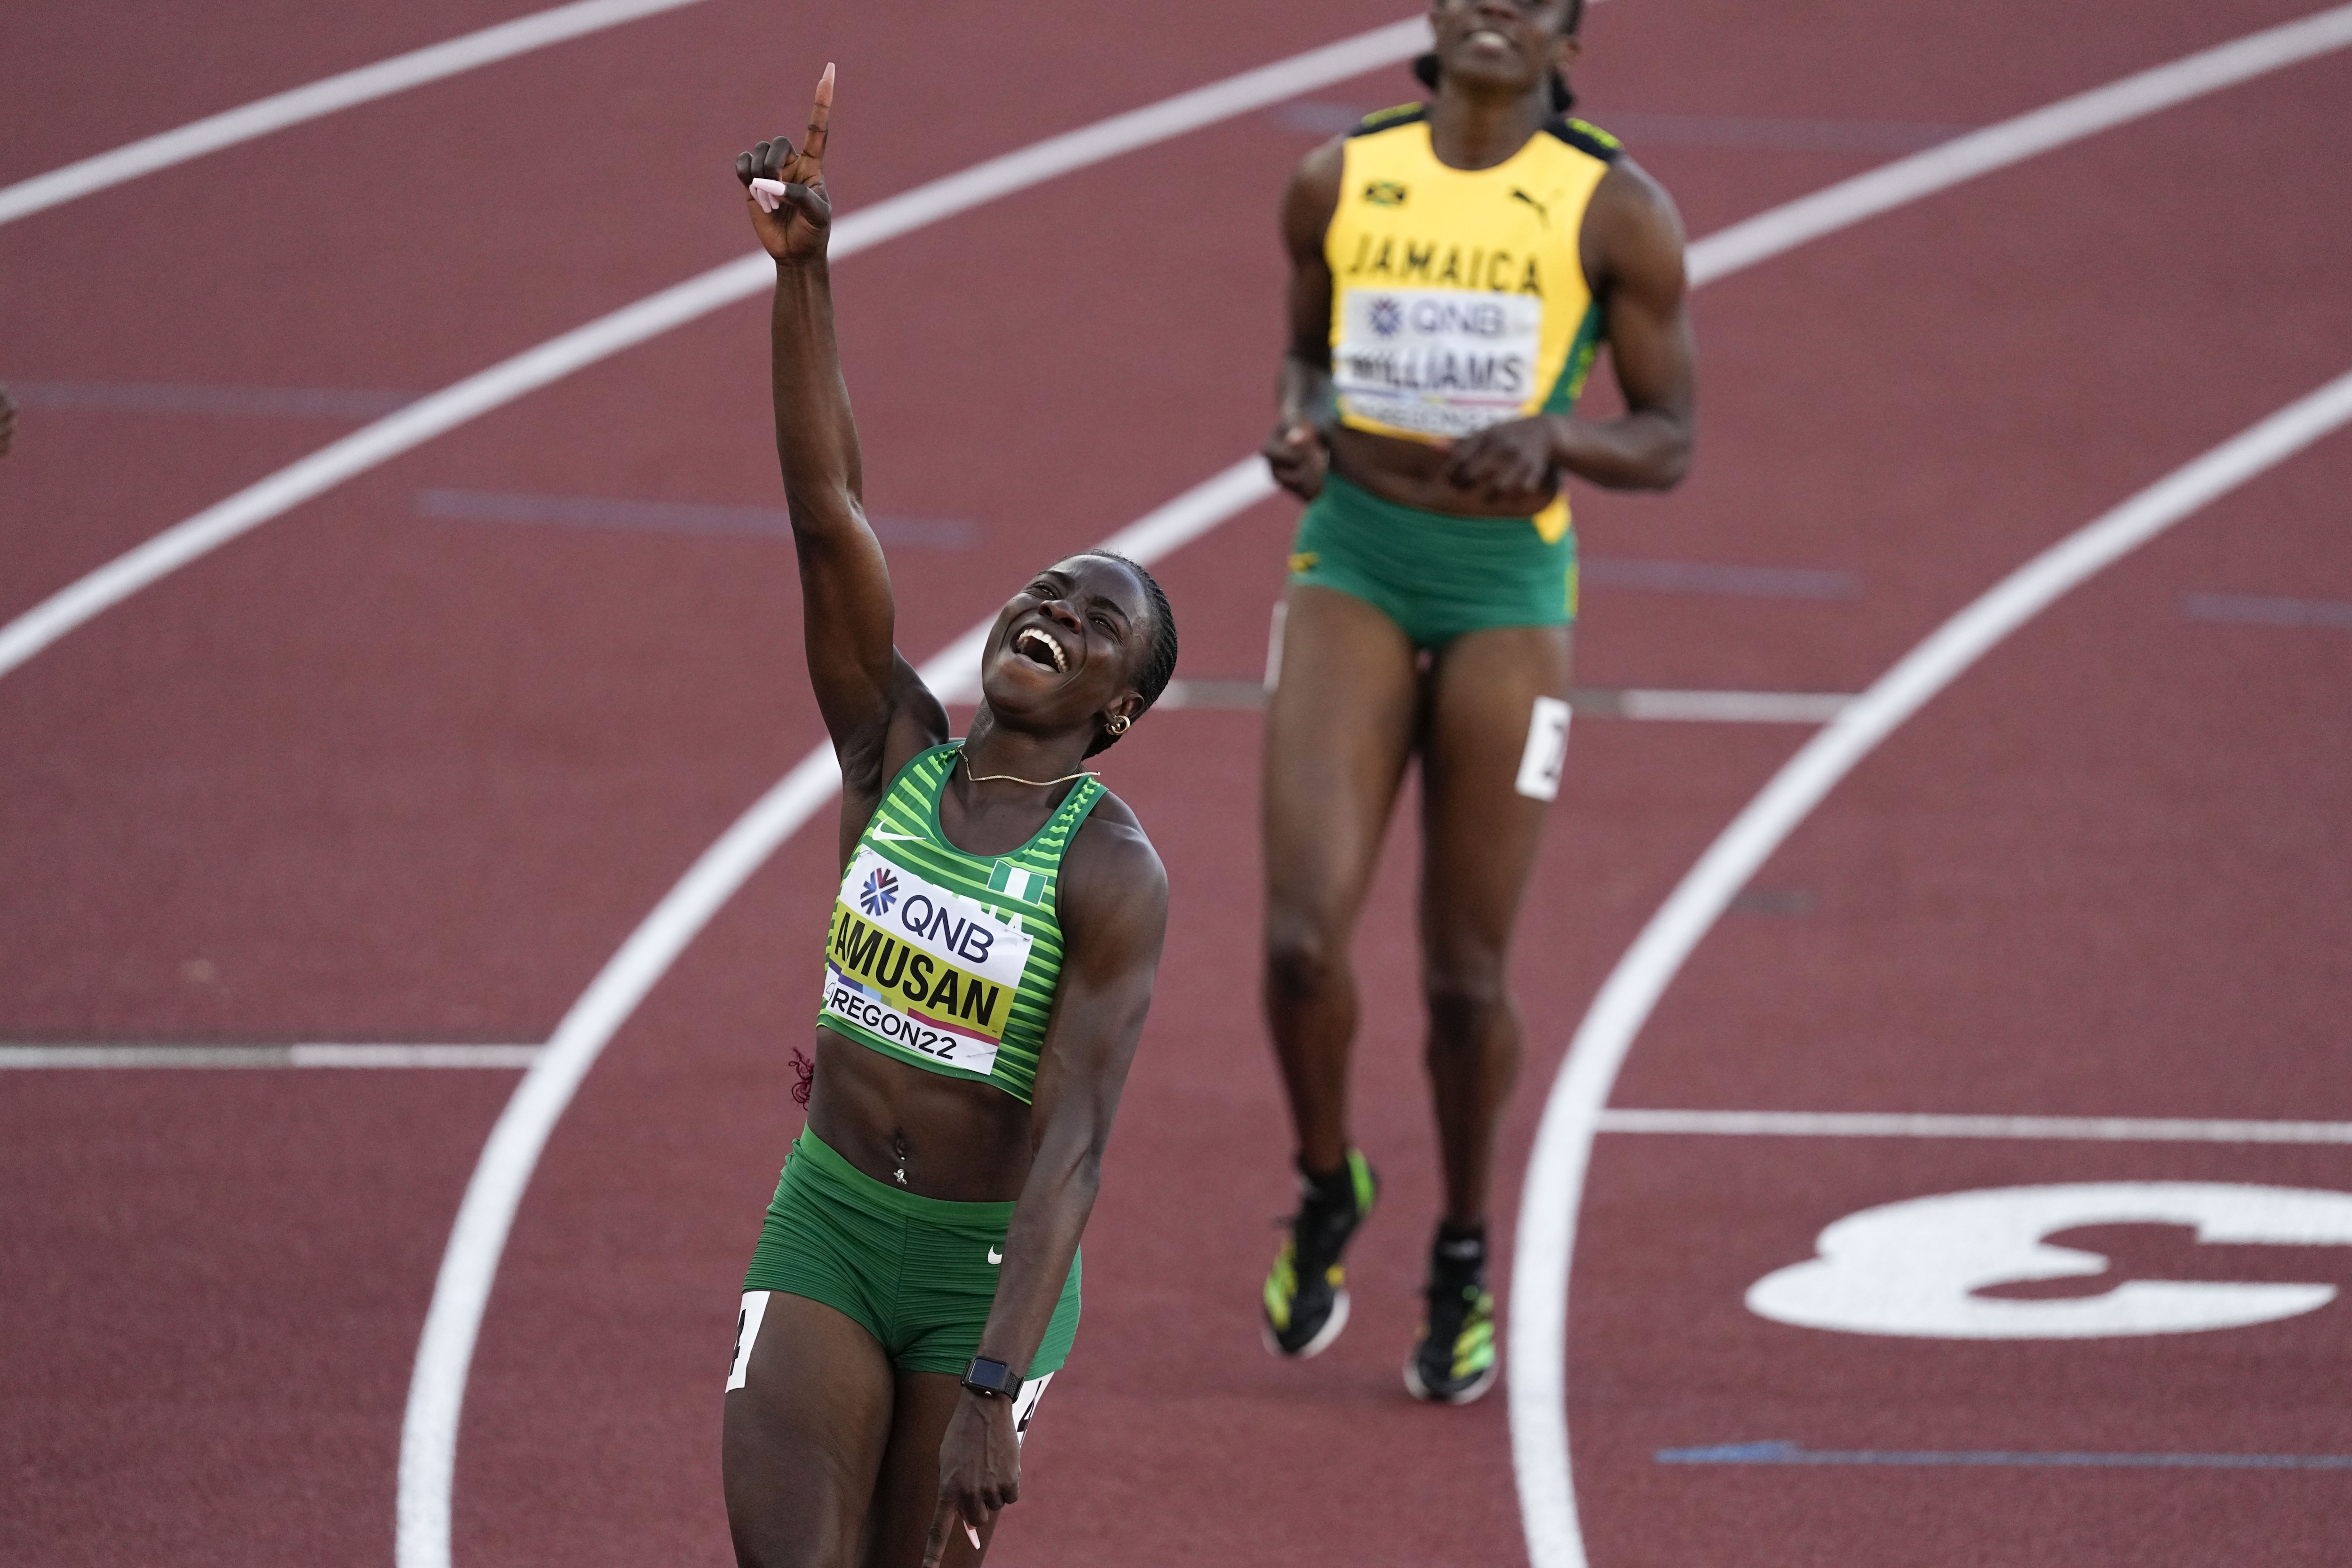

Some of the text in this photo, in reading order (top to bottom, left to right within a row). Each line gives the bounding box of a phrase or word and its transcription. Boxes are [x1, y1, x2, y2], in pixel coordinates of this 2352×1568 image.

[1346, 234, 1545, 298] JAMAICA
[1411, 299, 1506, 337] QNB
[901, 894, 994, 963] QNB
[834, 911, 999, 1027] AMUSAN
[828, 986, 957, 1059] REGON22
[1744, 1179, 2352, 1341] 3
